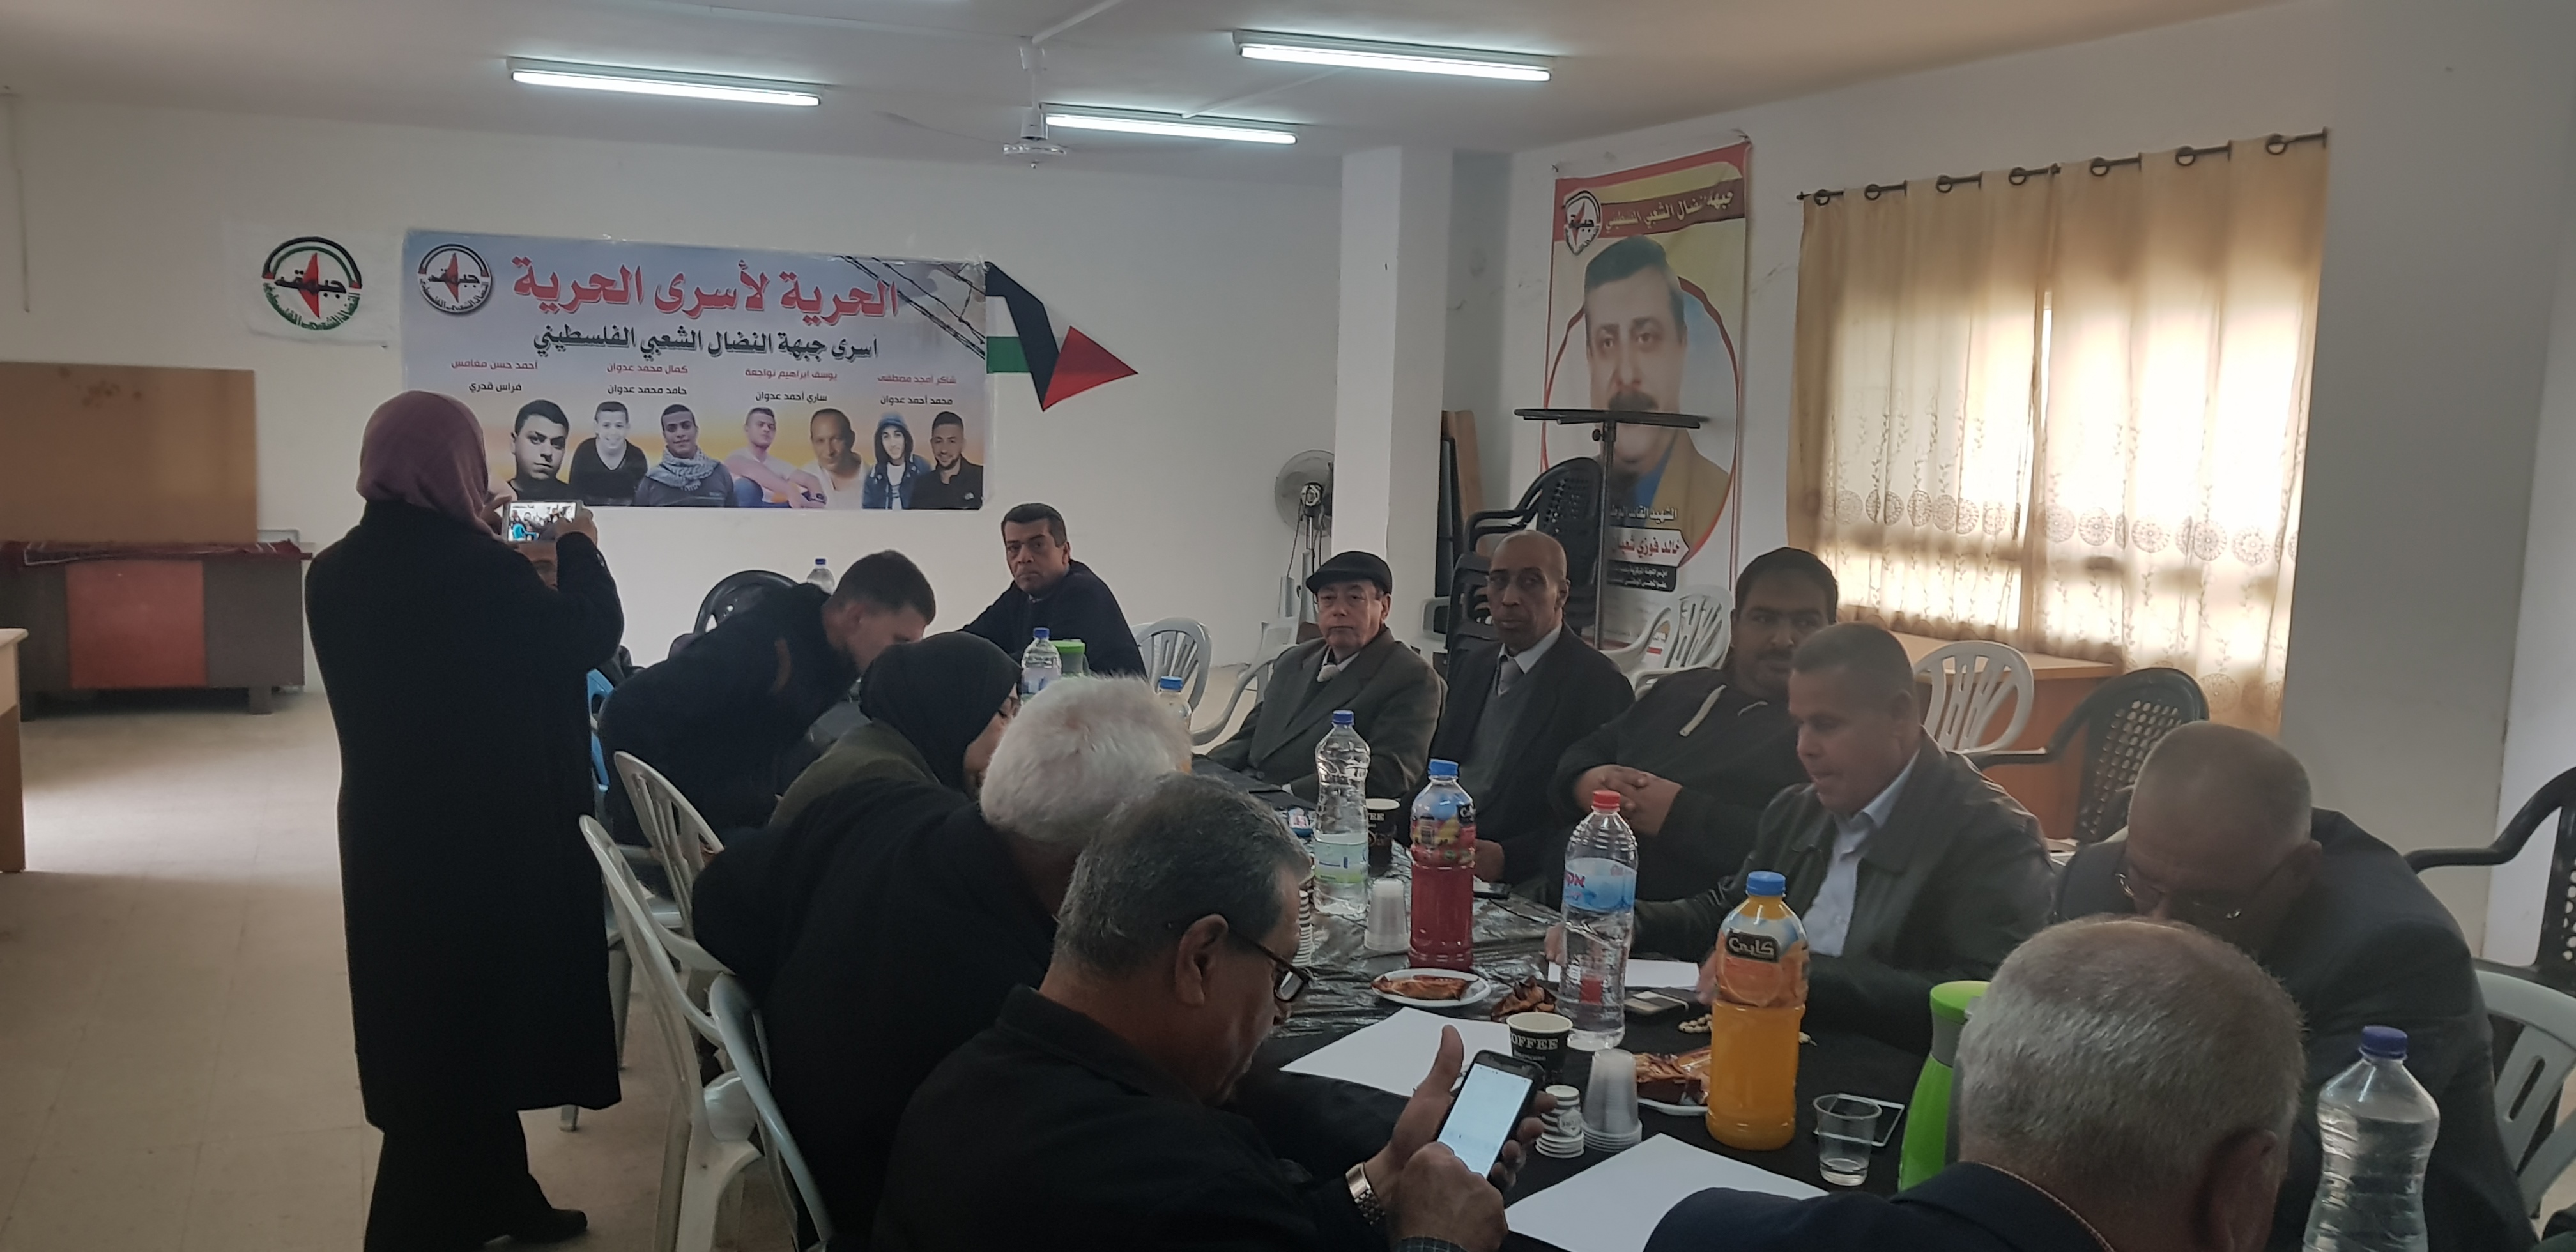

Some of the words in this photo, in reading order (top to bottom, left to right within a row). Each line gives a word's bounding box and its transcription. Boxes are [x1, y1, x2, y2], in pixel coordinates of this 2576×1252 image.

[511, 255, 644, 314] الحرية
[655, 259, 770, 320] لأسرى
[779, 270, 898, 326] الحرية
[533, 323, 636, 357] الفلسطيني
[640, 324, 703, 362] الشعبي
[707, 330, 774, 358] النضال
[777, 332, 828, 362] جبهة
[451, 358, 487, 369] مغامس
[490, 361, 512, 370] حسن
[607, 362, 634, 374] عدوان
[665, 365, 689, 375] كمال
[811, 371, 838, 381] يوسف
[877, 374, 912, 383] مصطفى
[468, 381, 494, 393] قدري
[495, 382, 522, 394] فراس
[608, 384, 635, 395] عدوان
[666, 386, 687, 395] حامد
[755, 391, 781, 402] عدوان
[806, 393, 828, 404] ساري
[880, 395, 905, 406] عدوان
[1637, 537, 1659, 558] فوزي
[1510, 1032, 1559, 1050] OFFEE
